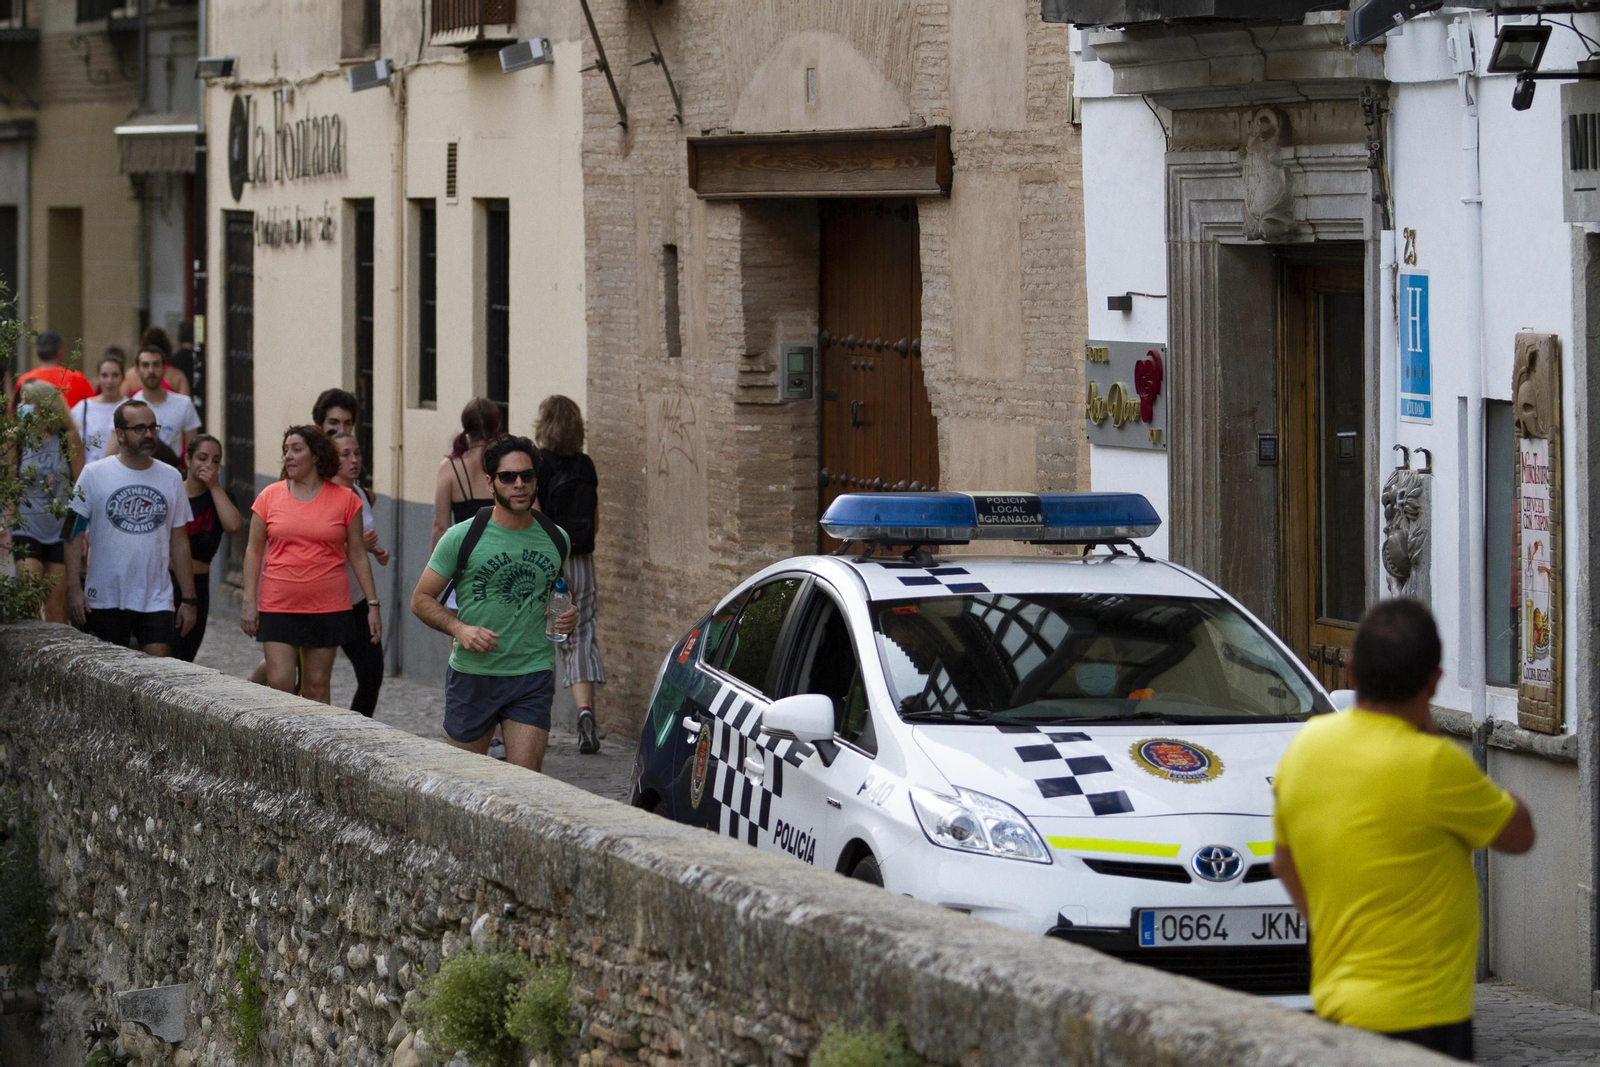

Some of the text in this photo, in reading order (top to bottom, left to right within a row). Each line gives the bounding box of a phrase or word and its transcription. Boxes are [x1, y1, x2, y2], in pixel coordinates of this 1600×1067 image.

[273, 90, 342, 181] Fontana
[1403, 226, 1417, 266] 23
[1406, 287, 1423, 353] H
[116, 487, 161, 503] AUTHENTIC
[107, 498, 166, 520] Hilfiger
[984, 515, 1037, 523] GRANADA
[991, 505, 1026, 513] LOCAL
[120, 520, 154, 532] BRAND
[471, 551, 512, 601] COLUMBIA
[87, 587, 98, 599] 02
[773, 818, 816, 866] POLICÍA
[1161, 912, 1300, 941] 0664 JKN
